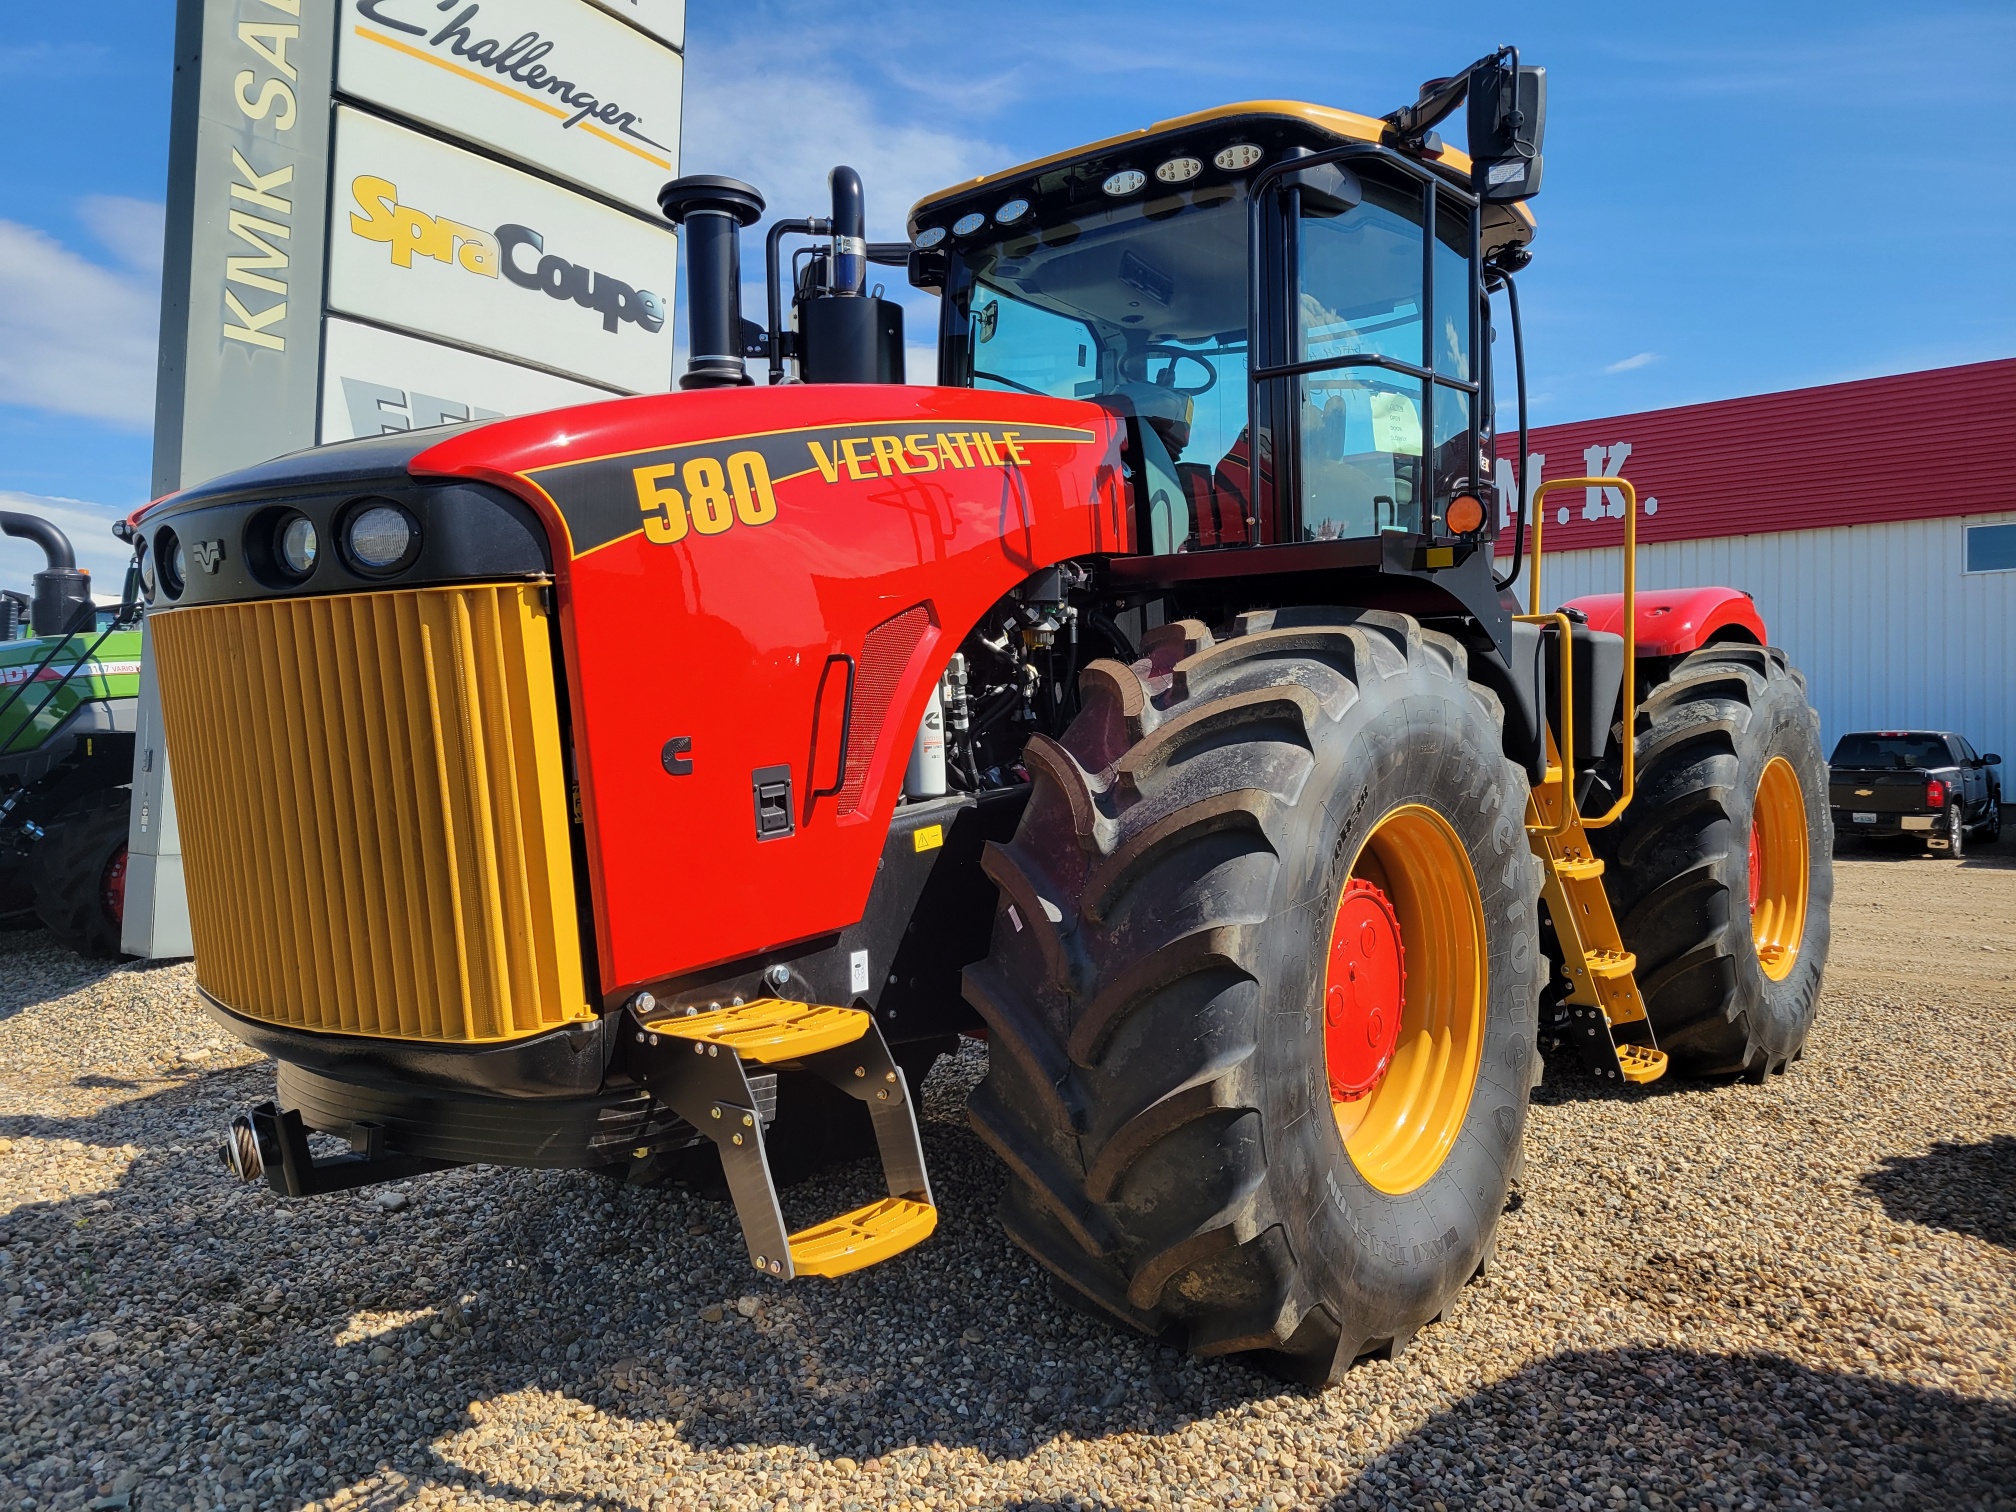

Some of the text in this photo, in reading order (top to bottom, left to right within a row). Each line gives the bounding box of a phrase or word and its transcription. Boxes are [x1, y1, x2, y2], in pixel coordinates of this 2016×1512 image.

[356, 0, 671, 153] Challenger
[224, 145, 295, 351] KMK
[349, 174, 665, 334] SpraCoupe
[633, 432, 1031, 545] 580 VERSATILE
[111, 665, 134, 673] VARIO
[1410, 1225, 1461, 1265] MAXI
